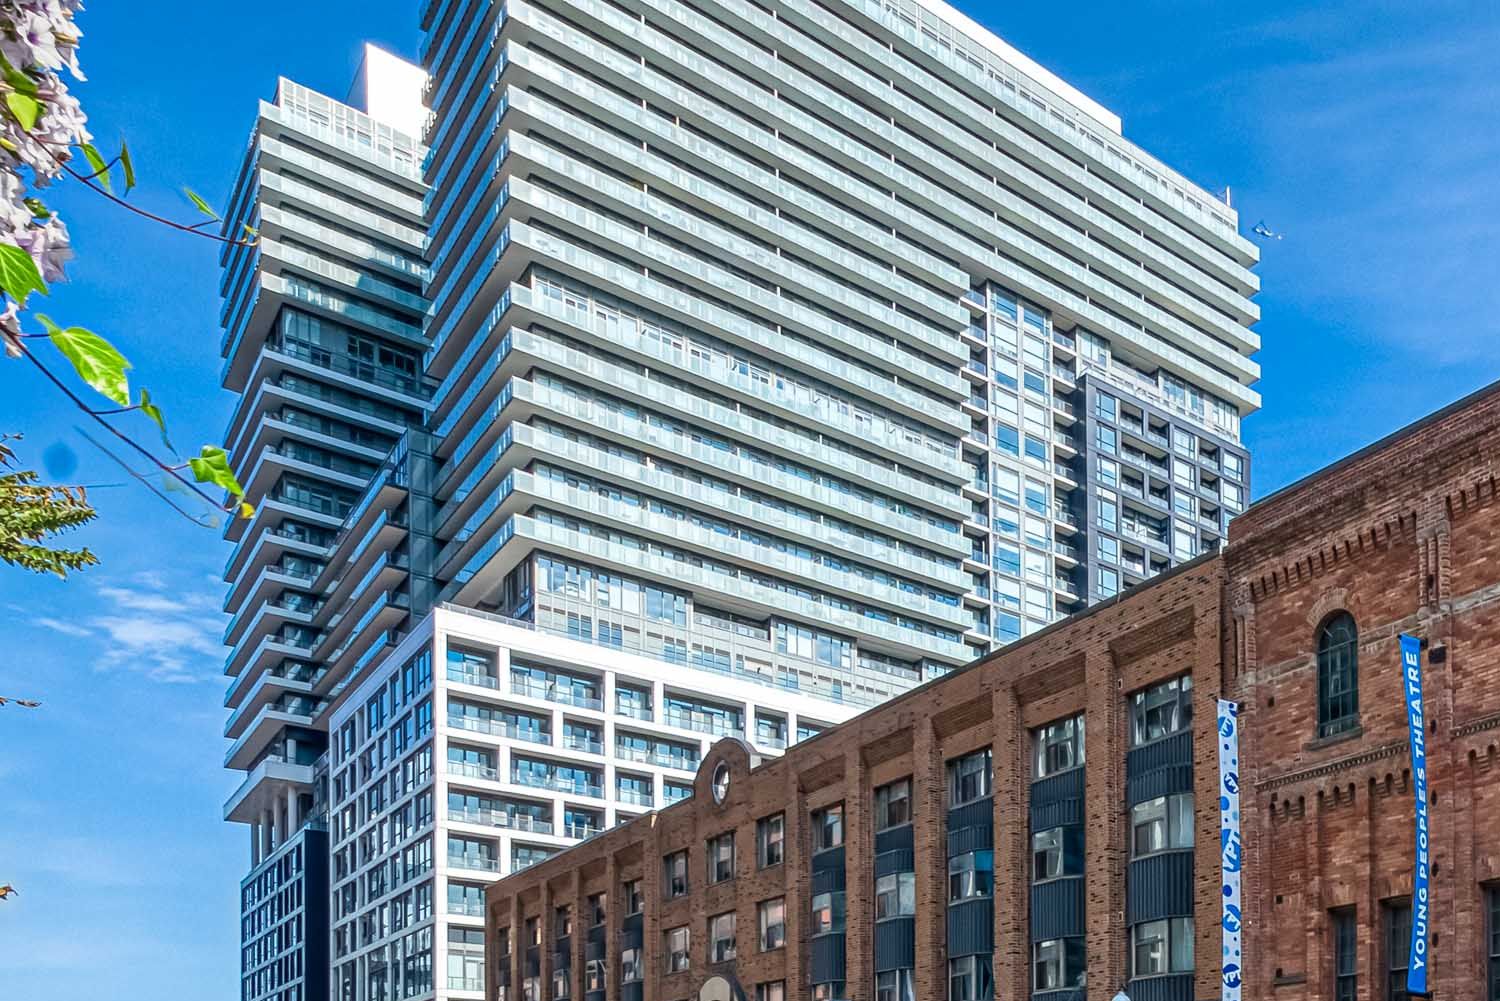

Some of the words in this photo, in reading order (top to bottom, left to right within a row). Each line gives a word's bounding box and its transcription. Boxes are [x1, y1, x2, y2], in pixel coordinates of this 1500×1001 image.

[1405, 651, 1424, 759] THEATRE
[1416, 767, 1428, 880] PEOPLE'S
[1413, 887, 1428, 971] YOUNG
[1222, 971, 1241, 985] YPT
